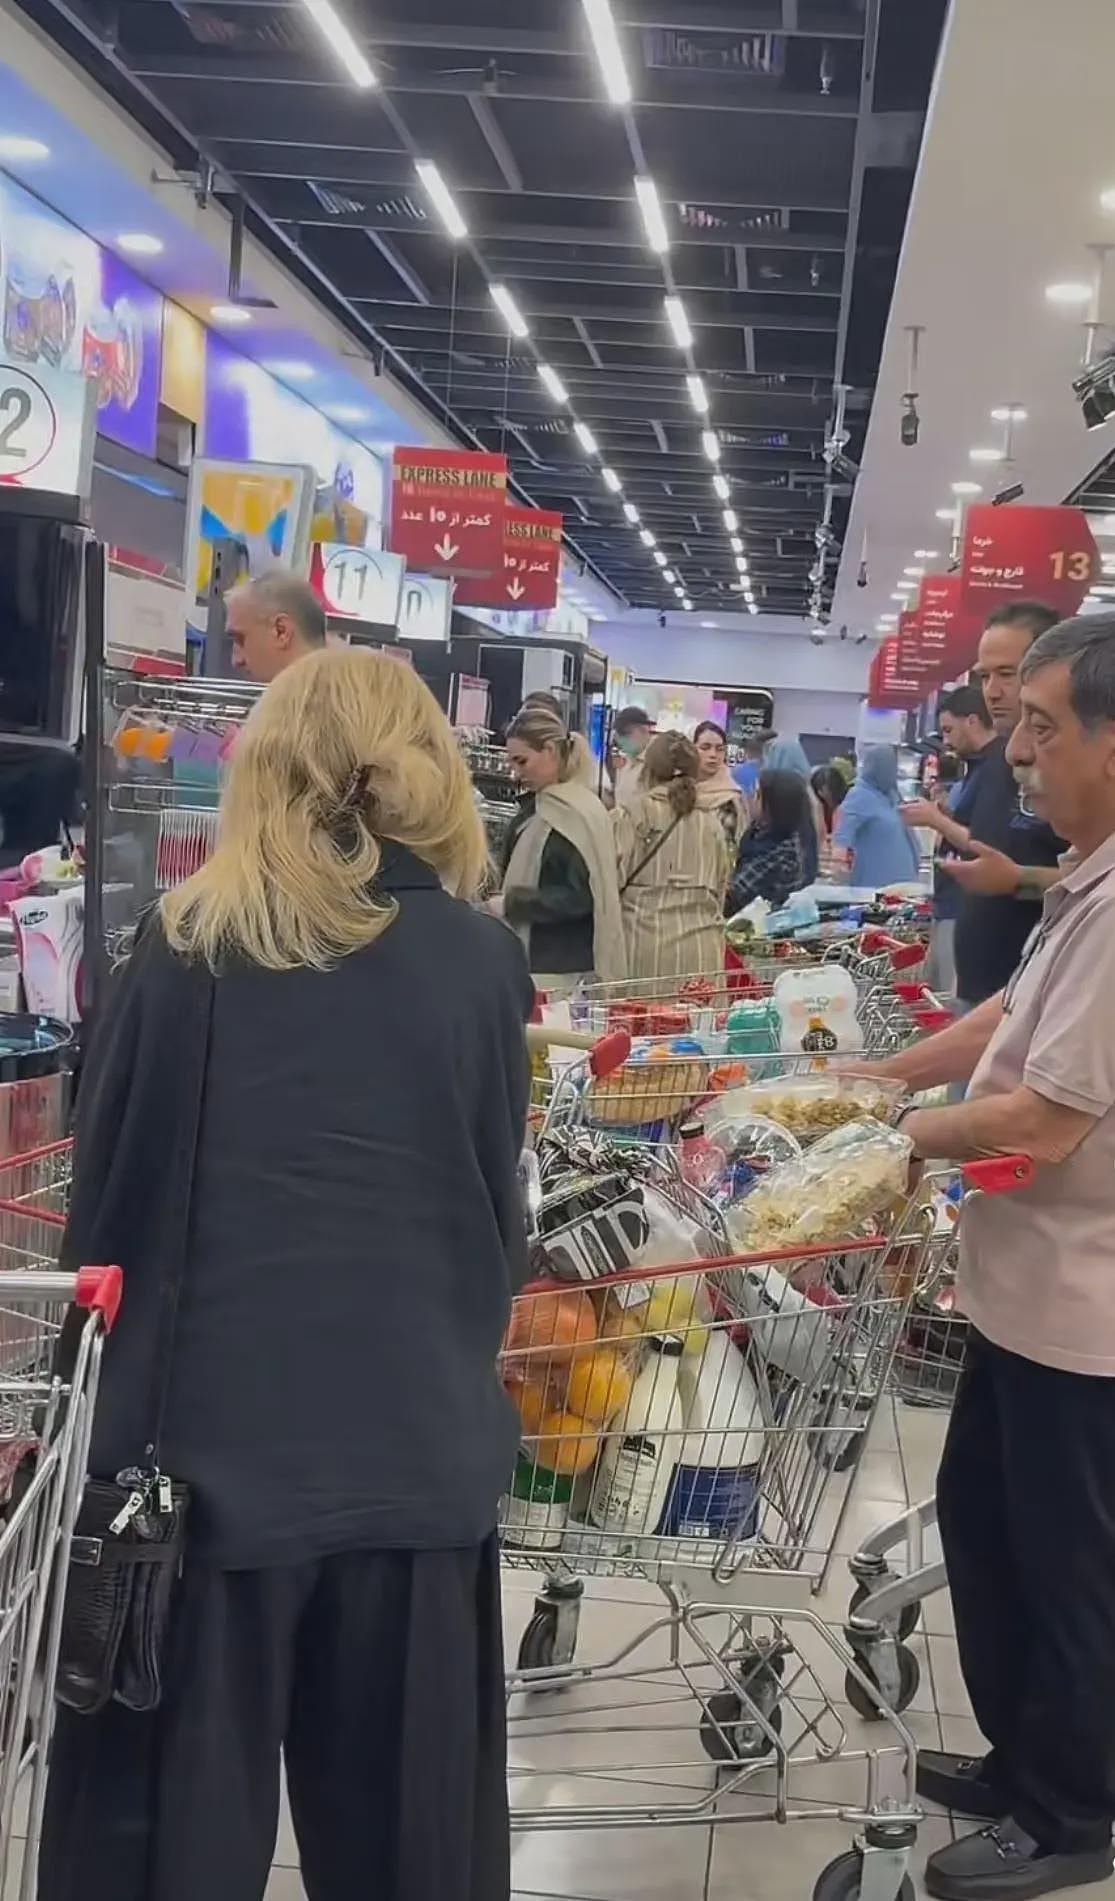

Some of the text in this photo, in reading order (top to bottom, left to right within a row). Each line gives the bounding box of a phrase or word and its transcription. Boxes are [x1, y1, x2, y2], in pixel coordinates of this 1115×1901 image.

[400, 465, 496, 488] EXPRESS LANE
[400, 509, 424, 522] عدد
[449, 511, 460, 527] از
[462, 512, 494, 528] کمتر
[1049, 551, 1091, 581] 13
[333, 561, 368, 601] 11
